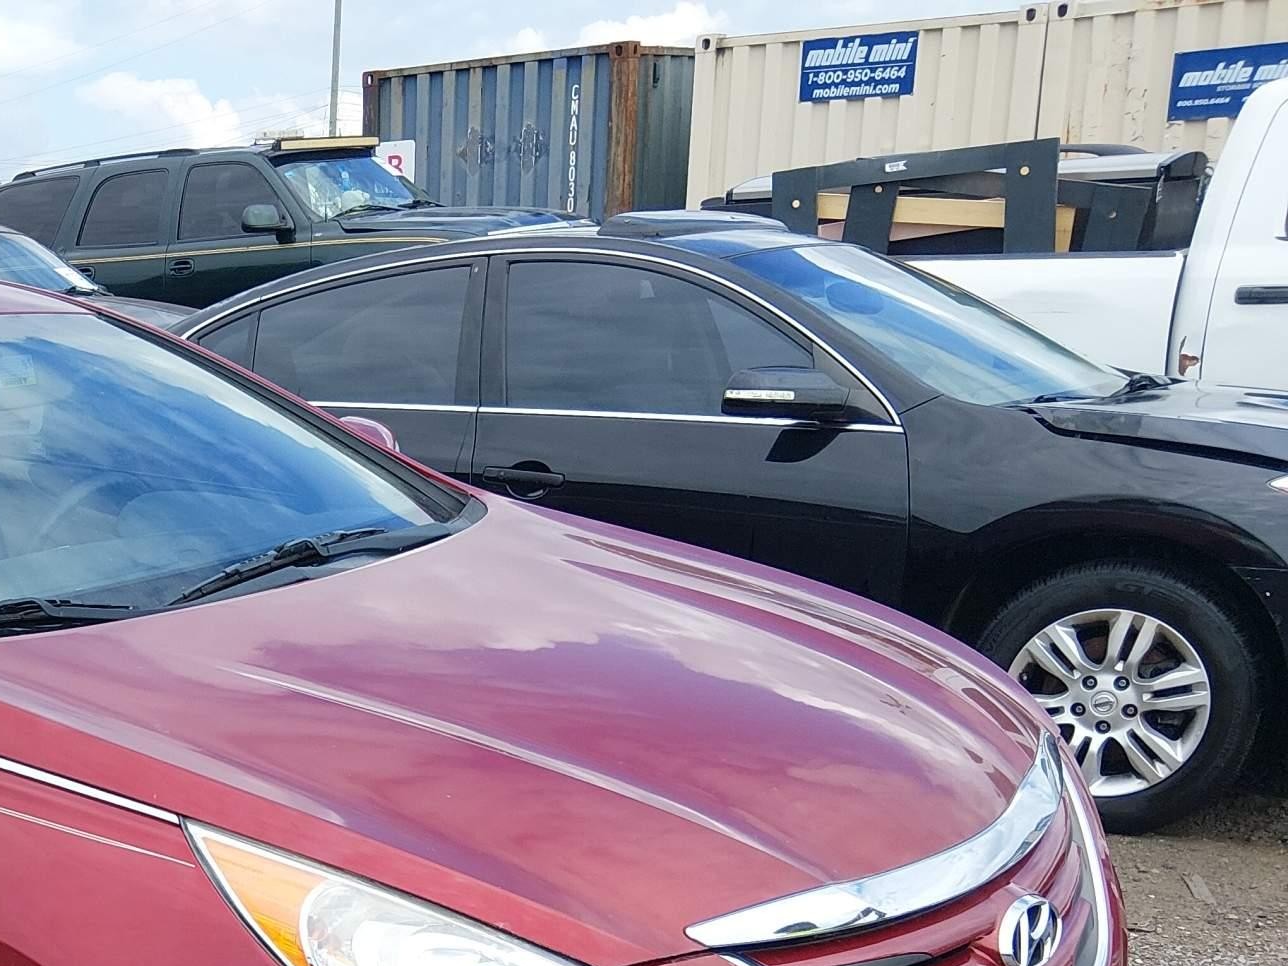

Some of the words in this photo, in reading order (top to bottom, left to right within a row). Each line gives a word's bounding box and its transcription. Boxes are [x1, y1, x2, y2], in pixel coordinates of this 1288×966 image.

[804, 38, 869, 68] mobile
[868, 37, 917, 63] mini
[808, 66, 907, 85] 1-800-950-6464
[1178, 60, 1254, 88] mobile
[812, 83, 900, 99] mobilemini.com
